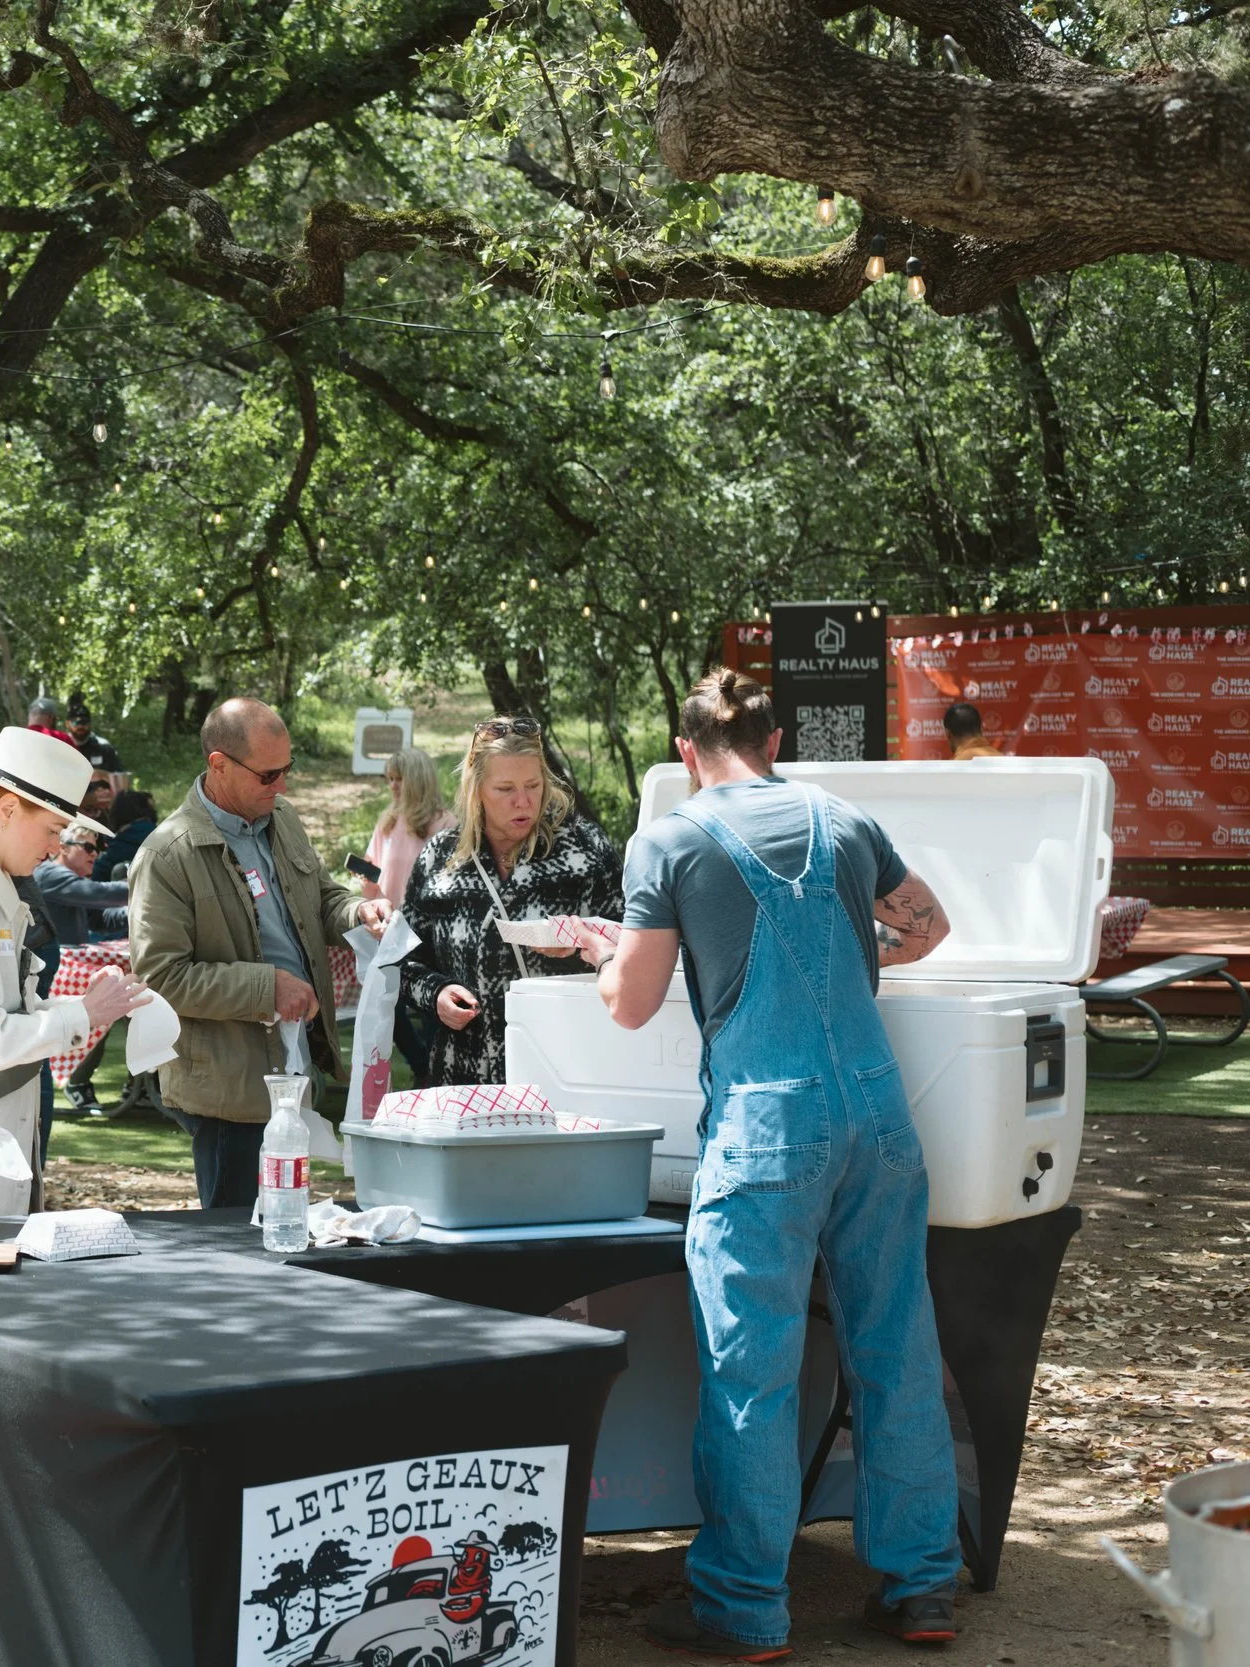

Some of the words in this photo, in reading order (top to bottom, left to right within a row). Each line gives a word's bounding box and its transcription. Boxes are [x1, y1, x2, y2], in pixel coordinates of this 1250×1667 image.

[1041, 643, 1078, 652] REALTY
[1167, 643, 1205, 651] REALTY
[922, 650, 957, 658] REALTY
[1042, 650, 1068, 660] HAUS
[1167, 651, 1194, 660] HAUS
[780, 659, 835, 671] REALTY
[839, 658, 879, 670] HAUS
[922, 659, 946, 668] HAUS
[980, 681, 1017, 689] REALTY
[1103, 678, 1139, 686] REALTY
[981, 689, 1007, 698] HAUS
[1103, 687, 1129, 695] HAUS
[1041, 714, 1076, 722] REALTY
[1165, 715, 1202, 723] REALTY
[1041, 722, 1067, 731] HAUS
[1165, 723, 1191, 732] HAUS
[1102, 750, 1140, 759] REALTY
[1166, 790, 1204, 799] REALTY
[1166, 798, 1193, 807] HAUS
[266, 1468, 387, 1539] LET'Z
[406, 1458, 546, 1497] GEAUX
[366, 1498, 452, 1540] BOIL
